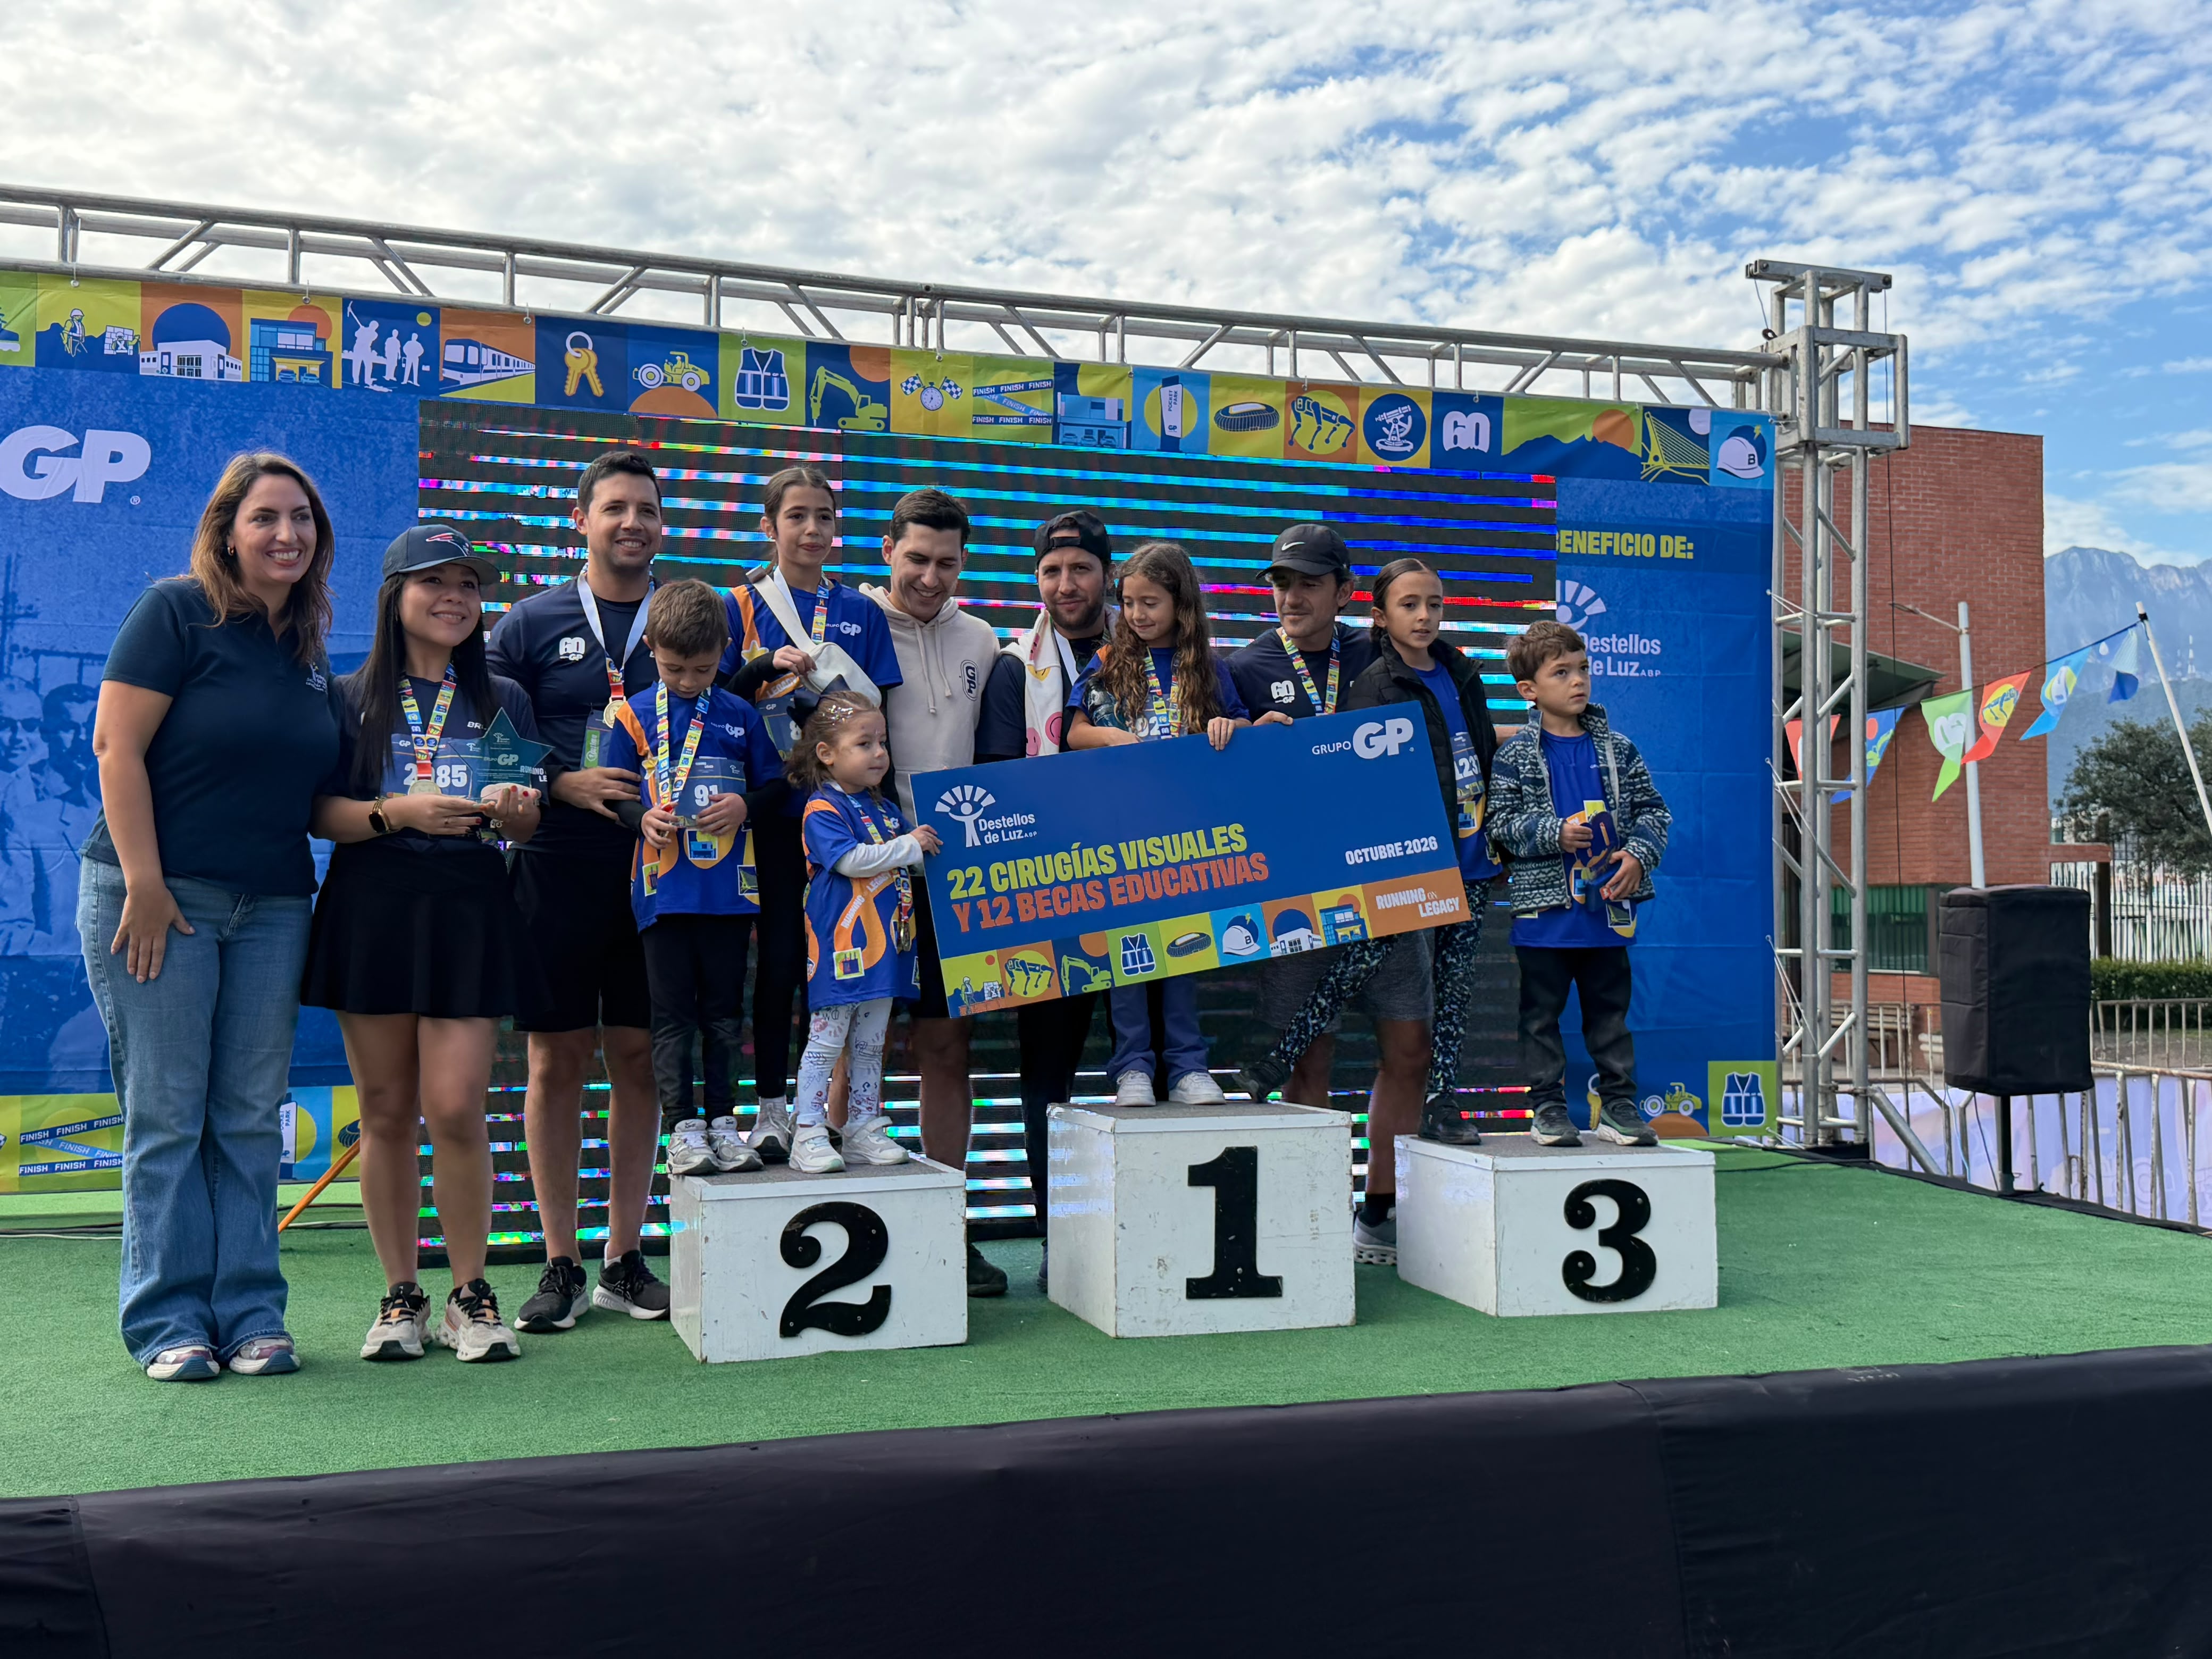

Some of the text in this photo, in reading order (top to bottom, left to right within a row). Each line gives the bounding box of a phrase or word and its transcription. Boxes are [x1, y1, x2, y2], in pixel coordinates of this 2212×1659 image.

[1002, 399, 1025, 412] FINISH
[1443, 410, 1490, 453] 60
[0, 425, 152, 503] GP
[1748, 454, 1756, 465] B
[1556, 530, 1694, 559] ENEFICIO DE:
[840, 621, 861, 636] GP
[559, 637, 585, 655] 60
[1607, 656, 1640, 677] Luz
[1271, 681, 1295, 699] 60
[1312, 718, 1414, 759] GRUPO GP
[497, 753, 519, 766] GP
[404, 763, 467, 787] 285
[978, 814, 1036, 831] Destellos
[984, 831, 1000, 844] de
[1001, 830, 1024, 841] Luz
[1345, 835, 1438, 865] OCTUBRE 2026
[947, 823, 1247, 900] 22 CIRUGÍAS VISUALES
[952, 852, 1269, 933] Y 12 BECAS EDUCATIVAS
[1376, 887, 1427, 910] RUNNING
[1418, 896, 1460, 918] LEGACY
[1244, 935, 1252, 945] B
[21, 1116, 124, 1142] FINISH FINISH FINISH
[59, 1141, 90, 1155] FINISH
[19, 1158, 122, 1174] FINISH FINISH FINISH
[1186, 1145, 1283, 1299] 1
[1562, 1178, 1657, 1303] 3
[780, 1201, 892, 1338] 2
